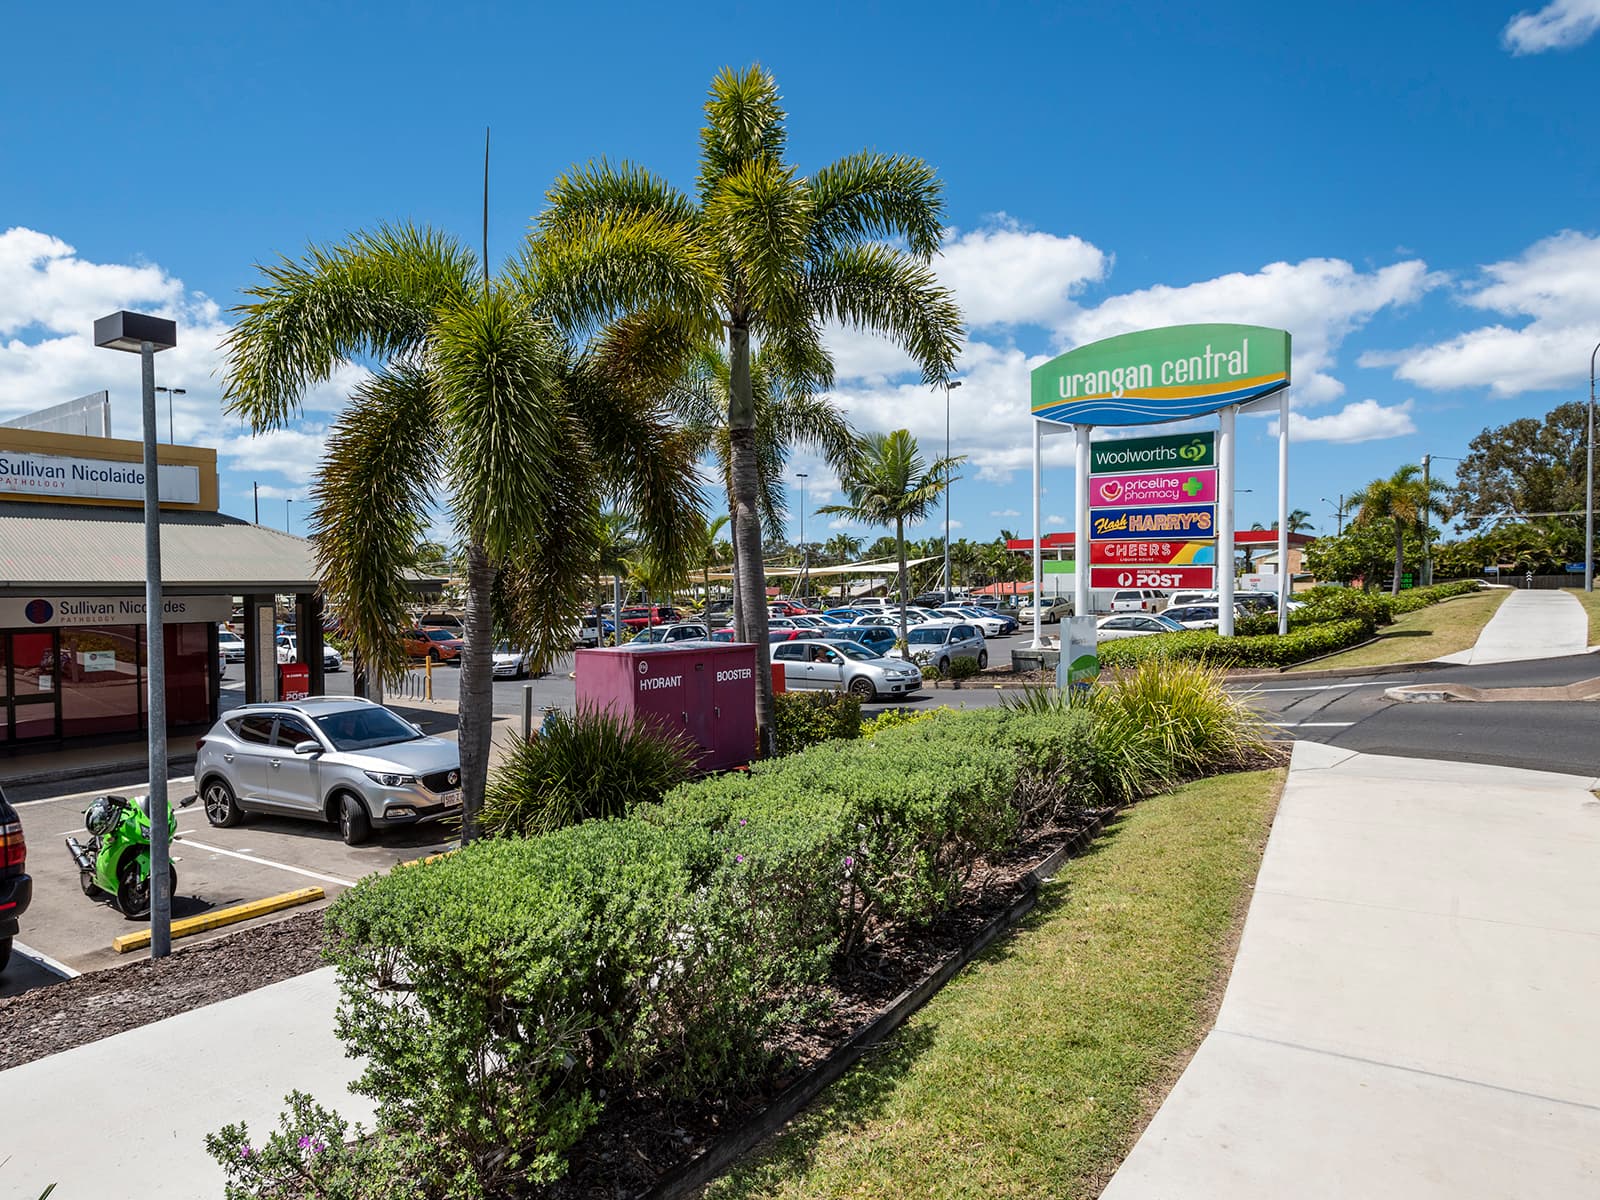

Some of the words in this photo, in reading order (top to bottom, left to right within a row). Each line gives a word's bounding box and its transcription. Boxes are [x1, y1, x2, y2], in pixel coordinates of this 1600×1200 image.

[1059, 363, 1152, 398] urangan
[1161, 339, 1248, 385] central
[1096, 445, 1177, 465] Woolworths
[0, 458, 65, 479] Sullivan
[72, 464, 145, 485] Nicolaide
[1125, 477, 1179, 496] priceline
[1125, 488, 1179, 502] pharmacy
[1094, 513, 1128, 534] Flash
[1128, 512, 1211, 531] HARRY'S
[1104, 543, 1171, 557] CHEERS
[1136, 574, 1183, 587] POST
[60, 601, 114, 615] Sullivan
[119, 600, 186, 614] Nicodes
[716, 668, 752, 682] BOOSTER
[640, 676, 682, 690] HYDRANT
